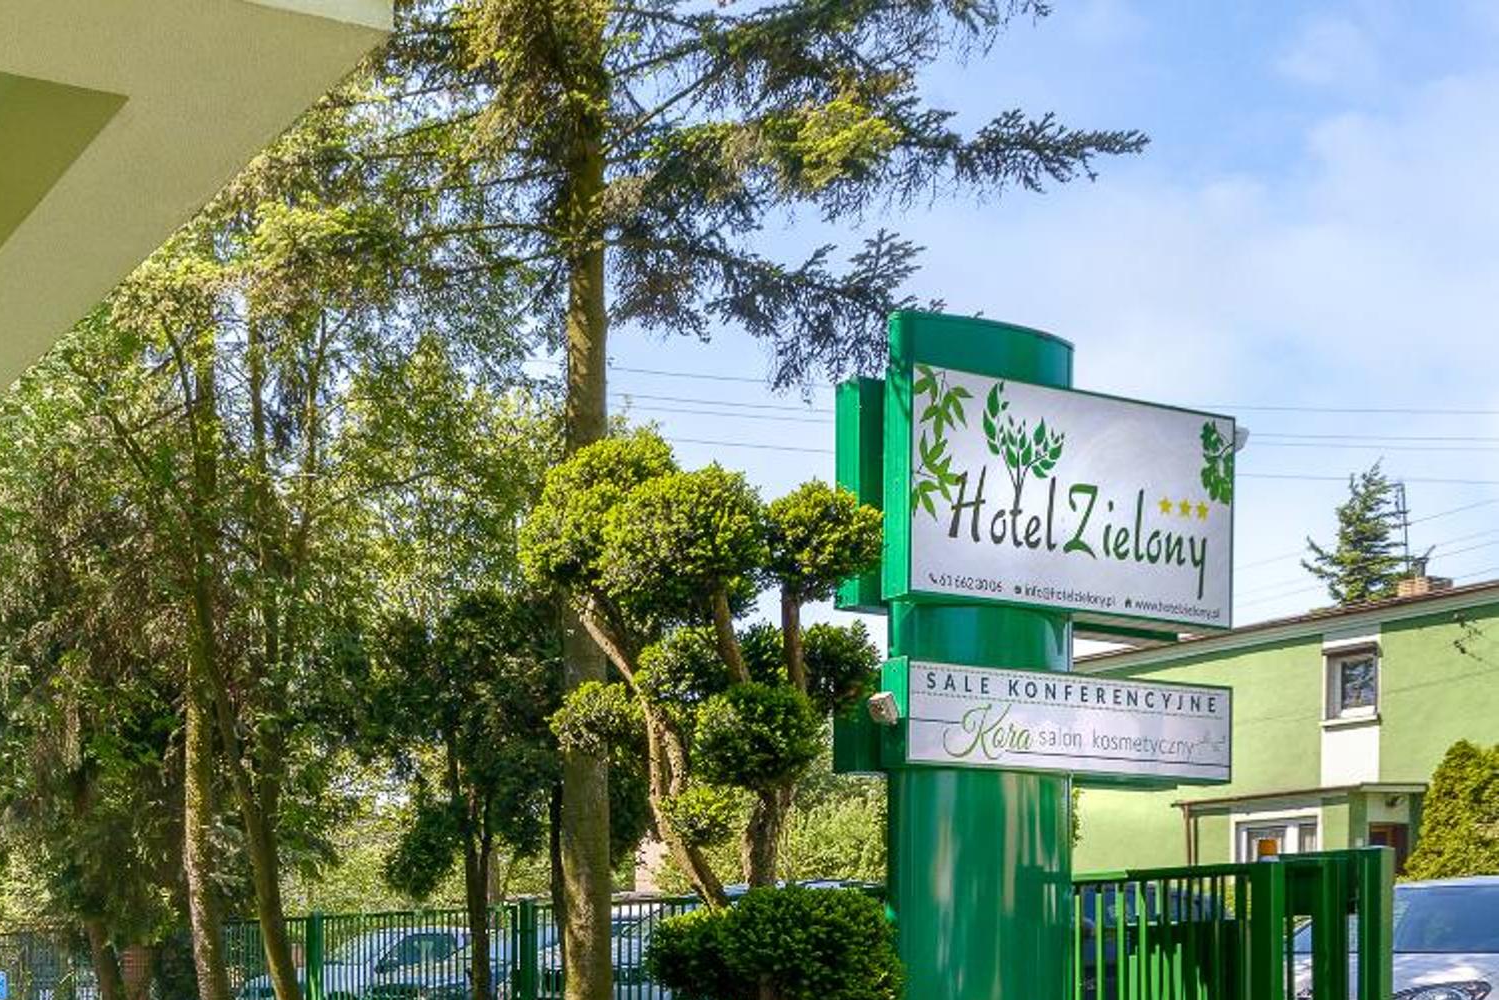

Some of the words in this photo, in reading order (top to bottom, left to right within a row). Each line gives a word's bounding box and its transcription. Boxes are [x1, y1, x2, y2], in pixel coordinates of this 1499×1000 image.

[949, 466, 1057, 551] Hotel
[1063, 483, 1207, 600] Zielony
[926, 671, 990, 695] SALE
[1008, 678, 1218, 714] KONFERENCYJNE
[942, 702, 1031, 760] Kora
[1038, 725, 1083, 749] salon
[1092, 726, 1195, 760] kosmetyczny
